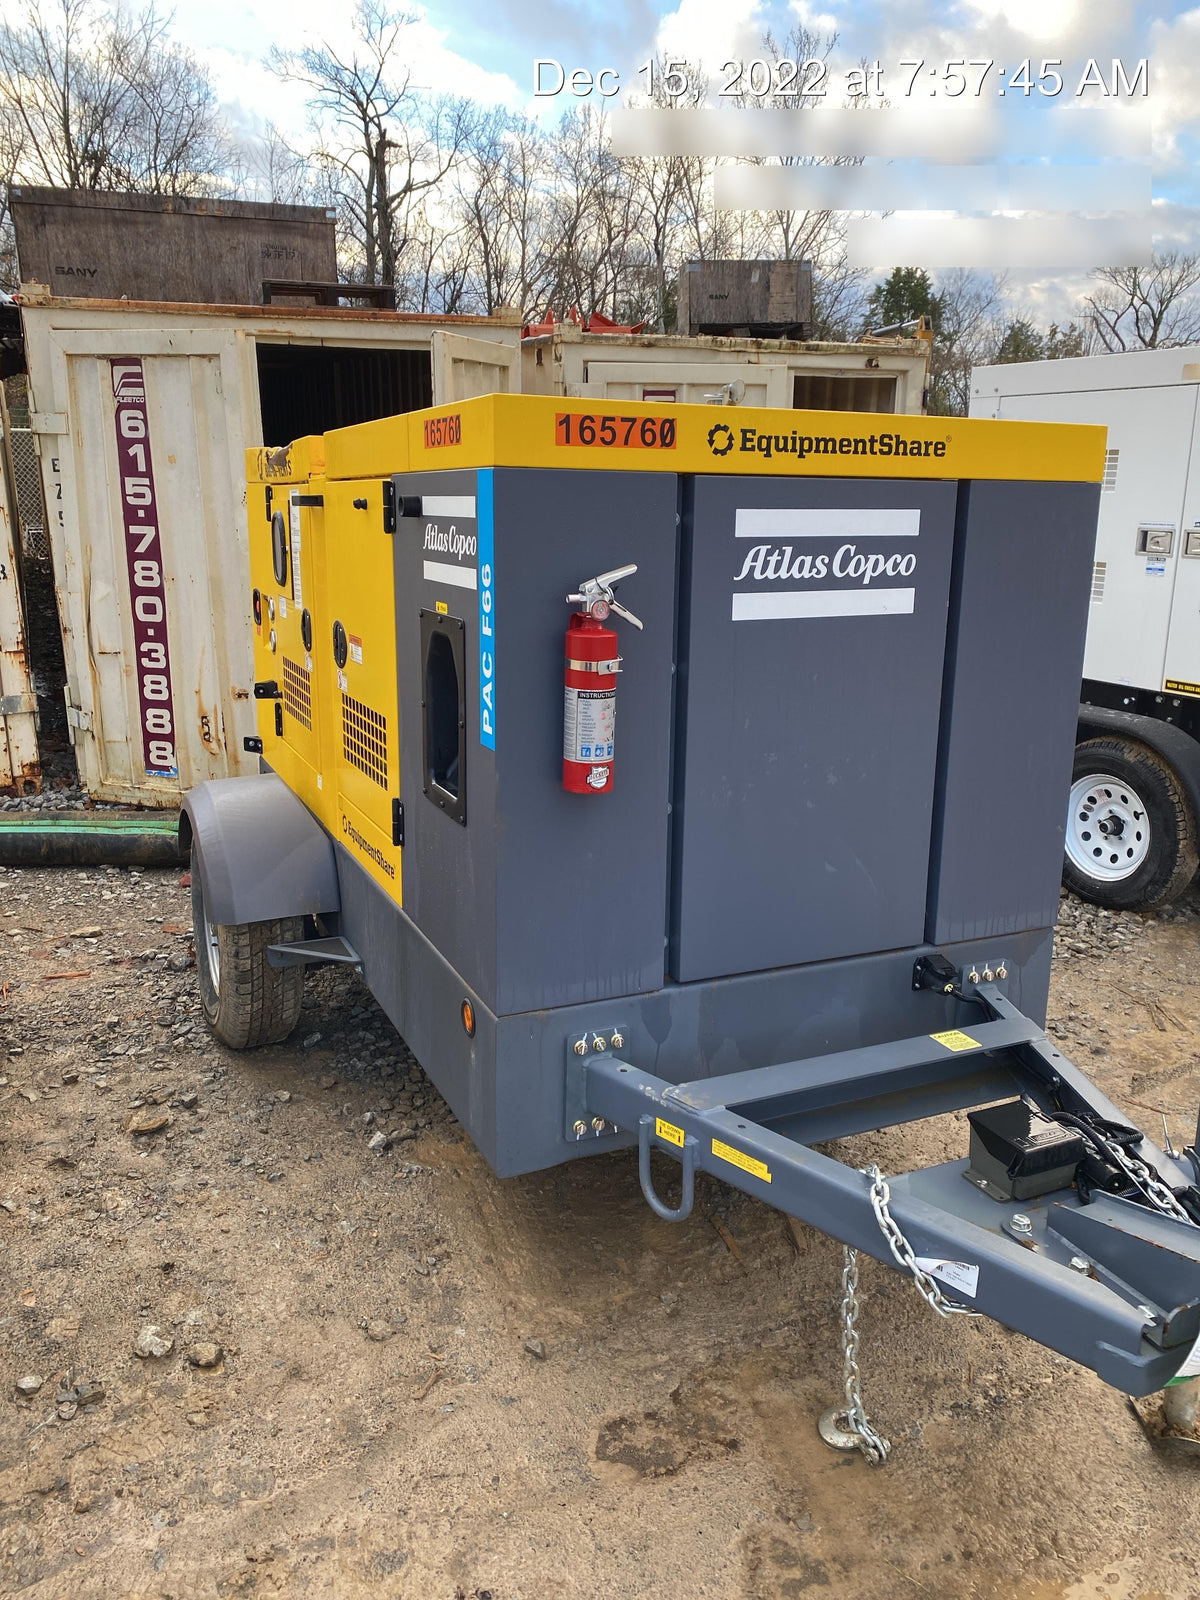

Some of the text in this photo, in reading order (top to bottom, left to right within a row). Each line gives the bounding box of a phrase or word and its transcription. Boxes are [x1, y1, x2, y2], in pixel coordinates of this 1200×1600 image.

[55, 266, 98, 278] SANY
[424, 413, 462, 447] 165760
[557, 413, 676, 448] 165760
[739, 428, 947, 459] EquipmentShare
[423, 523, 477, 561] Atlas Copco
[733, 543, 917, 585] Atlas Copco
[481, 563, 493, 735] PAC F66
[580, 691, 616, 699] INSTRUCTION
[348, 820, 395, 880] EquipmentShare
